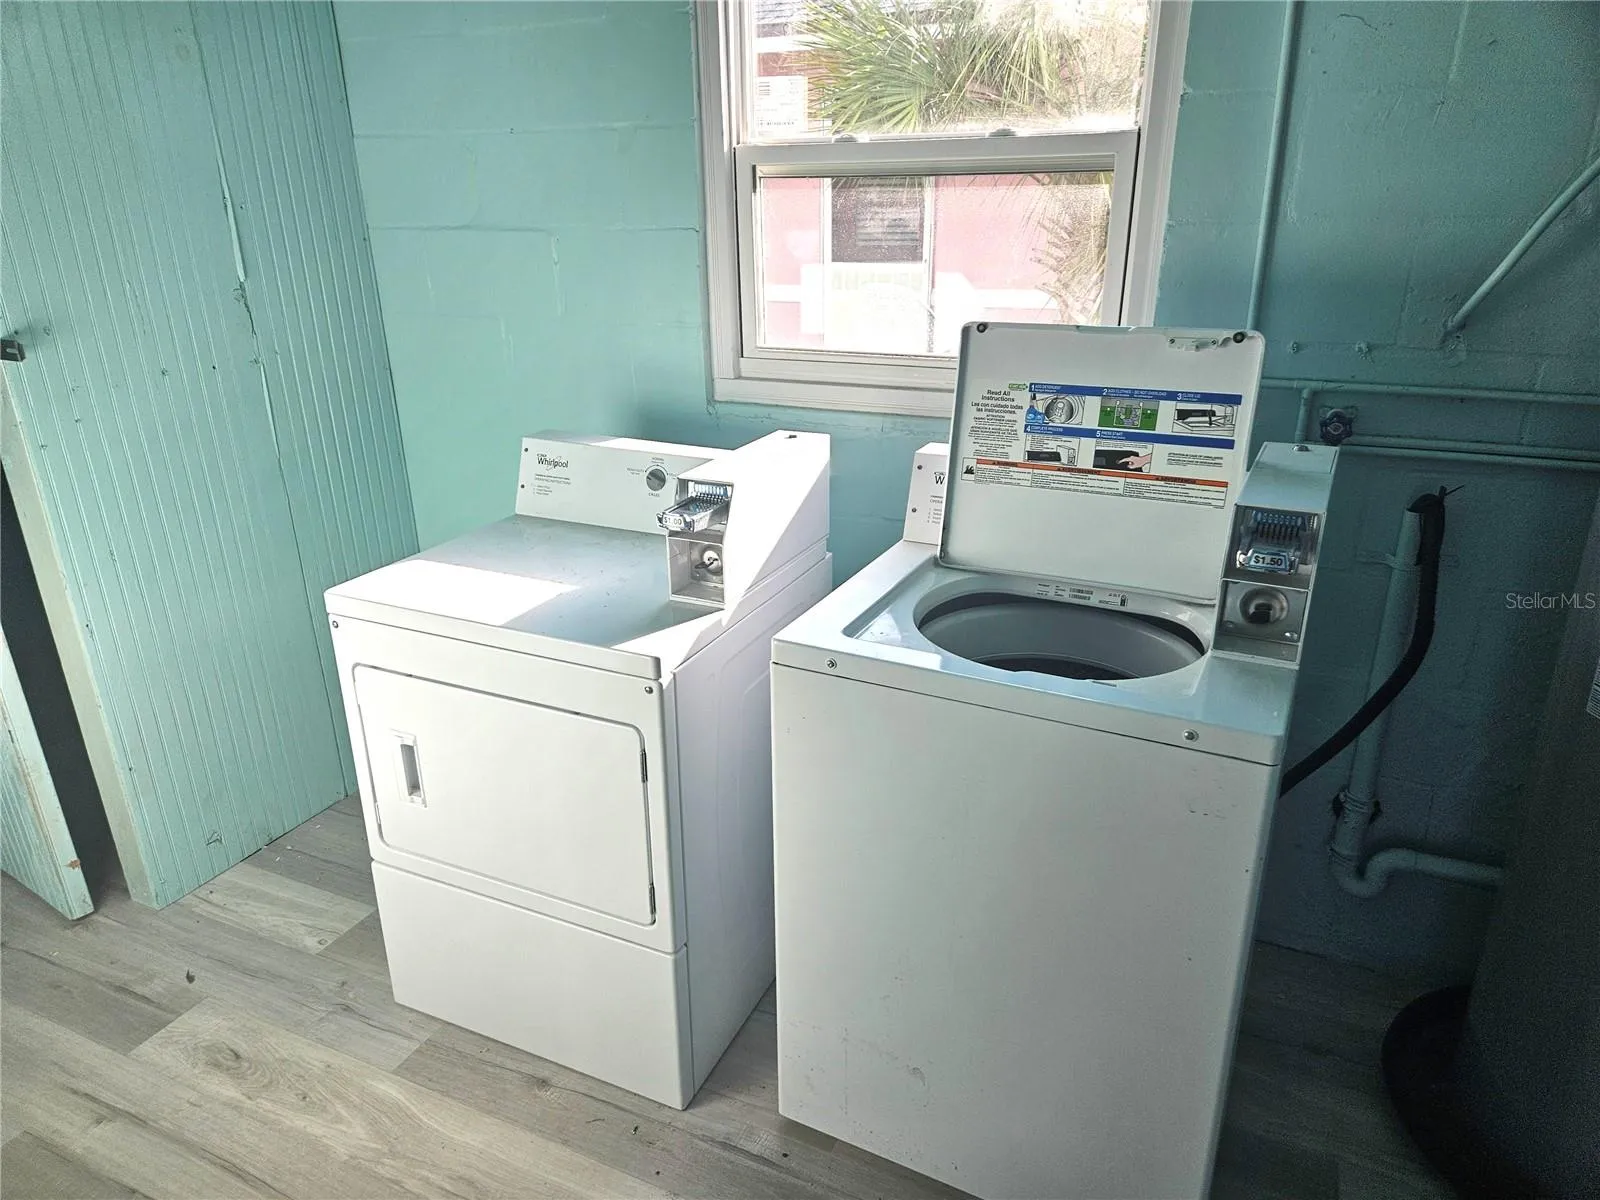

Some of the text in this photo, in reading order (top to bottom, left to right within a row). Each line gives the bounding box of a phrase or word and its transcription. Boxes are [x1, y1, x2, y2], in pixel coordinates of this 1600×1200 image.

[538, 456, 569, 469] Whirlpool
[935, 476, 945, 485] W
[1253, 555, 1283, 567] $1.50
